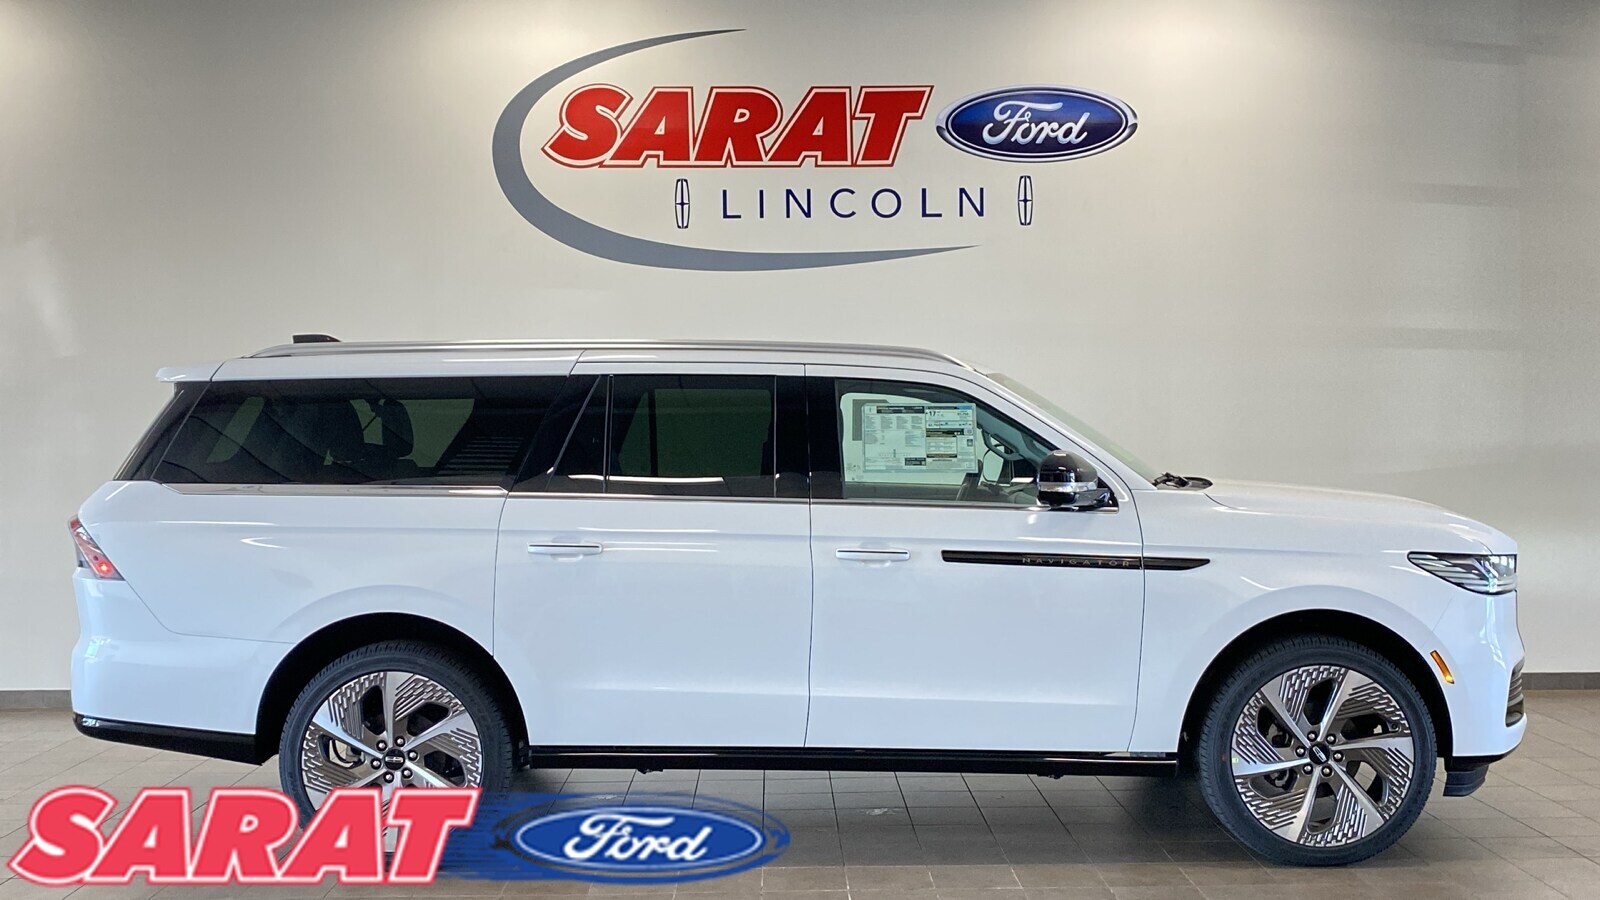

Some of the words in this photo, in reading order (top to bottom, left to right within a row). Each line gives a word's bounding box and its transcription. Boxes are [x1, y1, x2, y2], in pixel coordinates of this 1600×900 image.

[541, 84, 934, 168] SARAT
[982, 100, 1090, 145] Ford
[721, 187, 985, 218] LINCOLN
[1022, 557, 1130, 567] NAVIGATOR
